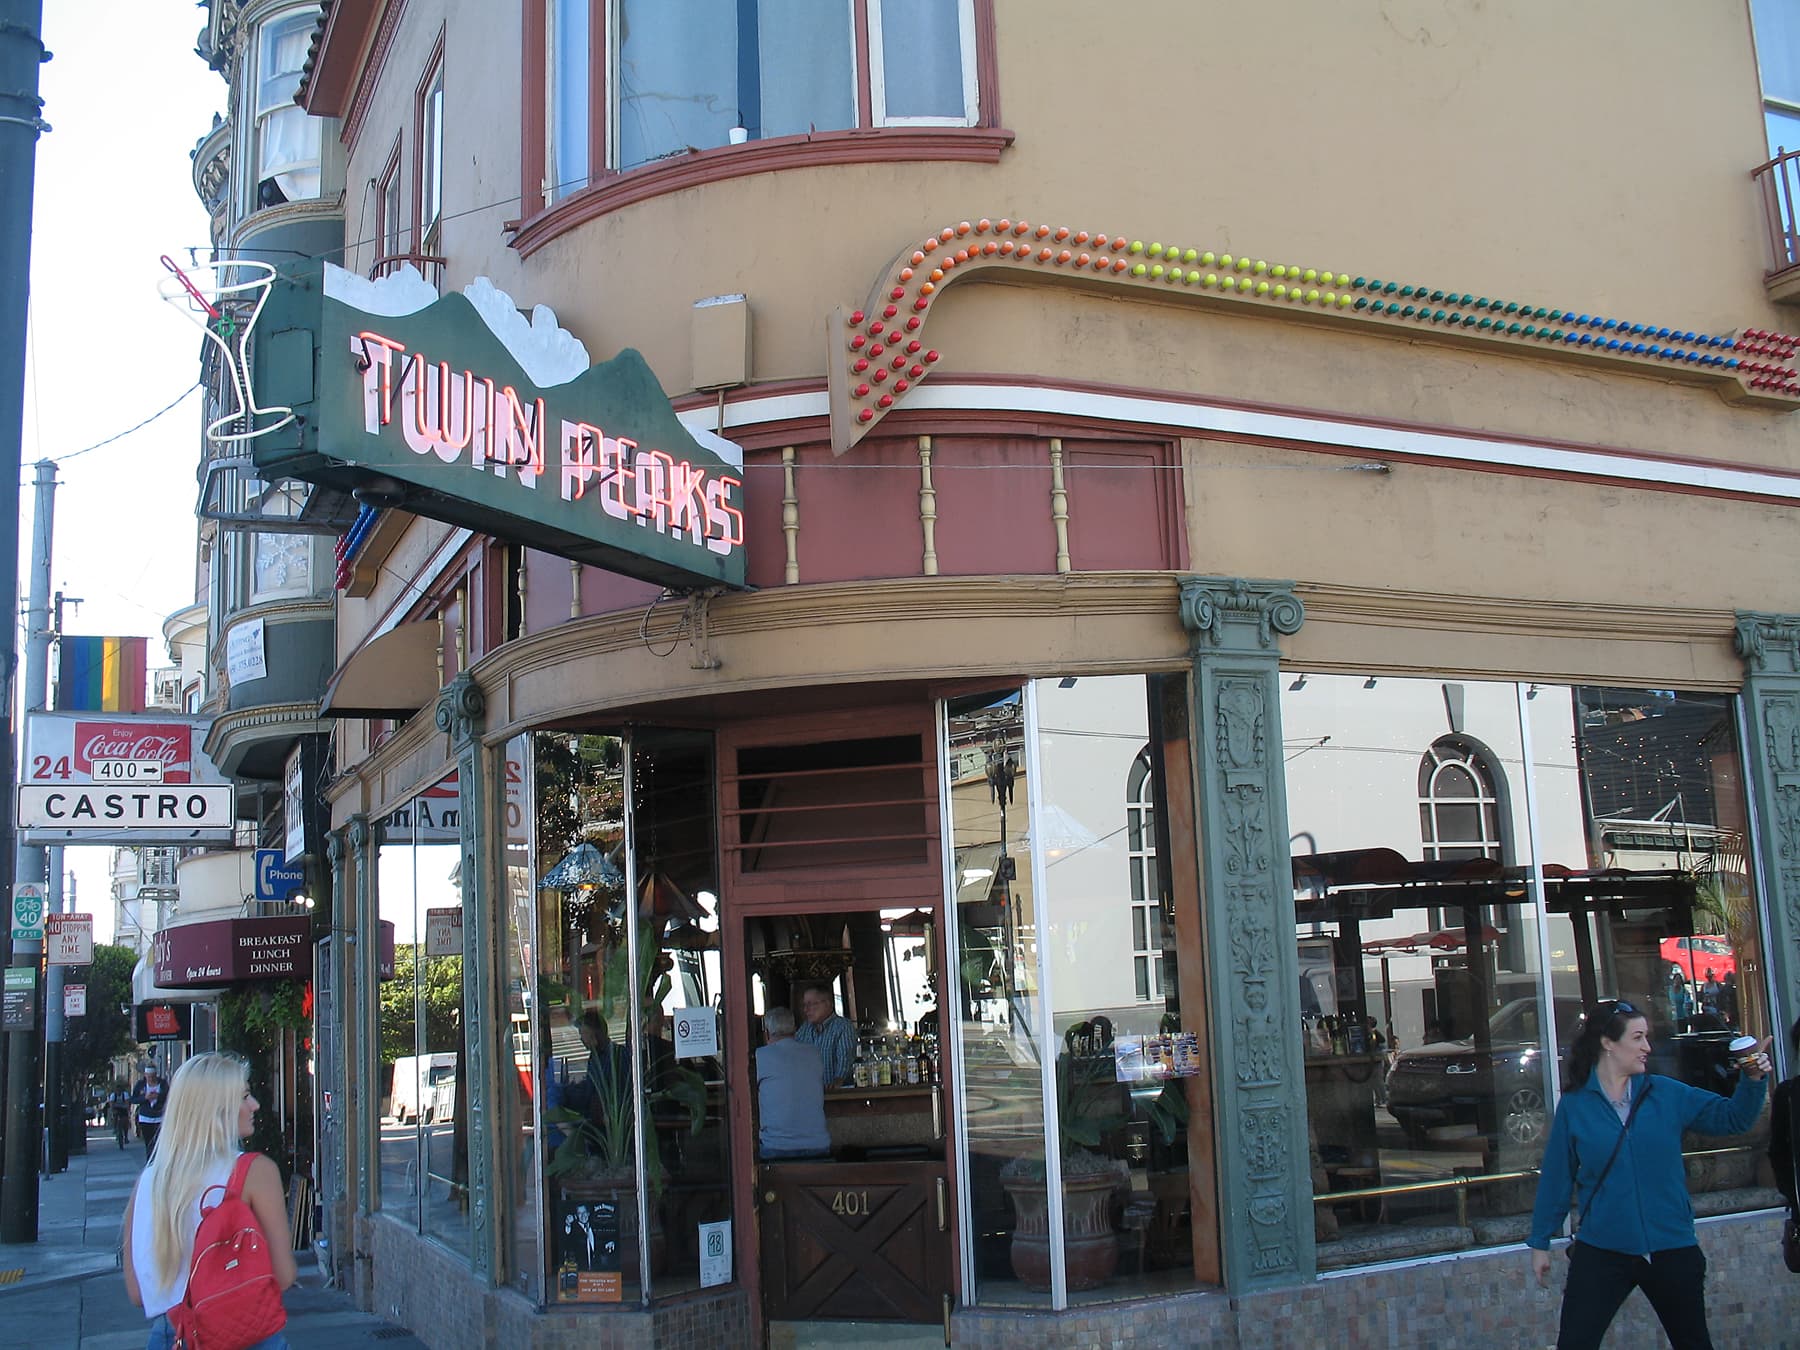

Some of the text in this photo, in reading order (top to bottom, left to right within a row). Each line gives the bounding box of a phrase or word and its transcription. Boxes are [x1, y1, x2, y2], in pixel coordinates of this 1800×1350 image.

[350, 331, 744, 556] TWIN PEAKS
[112, 728, 134, 738] Enjoy
[33, 755, 72, 780] 24
[100, 762, 137, 778] 400
[45, 793, 207, 819] CASTRO
[269, 869, 304, 880] Phone
[20, 911, 37, 924] 40
[18, 930, 38, 938] EAST
[48, 921, 91, 934] NO STOPPING
[62, 935, 79, 944] ANY
[239, 934, 303, 947] BREAKFAST
[60, 945, 80, 954] TIME
[252, 949, 290, 960] LUNCH
[186, 965, 222, 982] Open 24 hours
[250, 962, 294, 974] DINNER
[831, 1191, 870, 1216] 401
